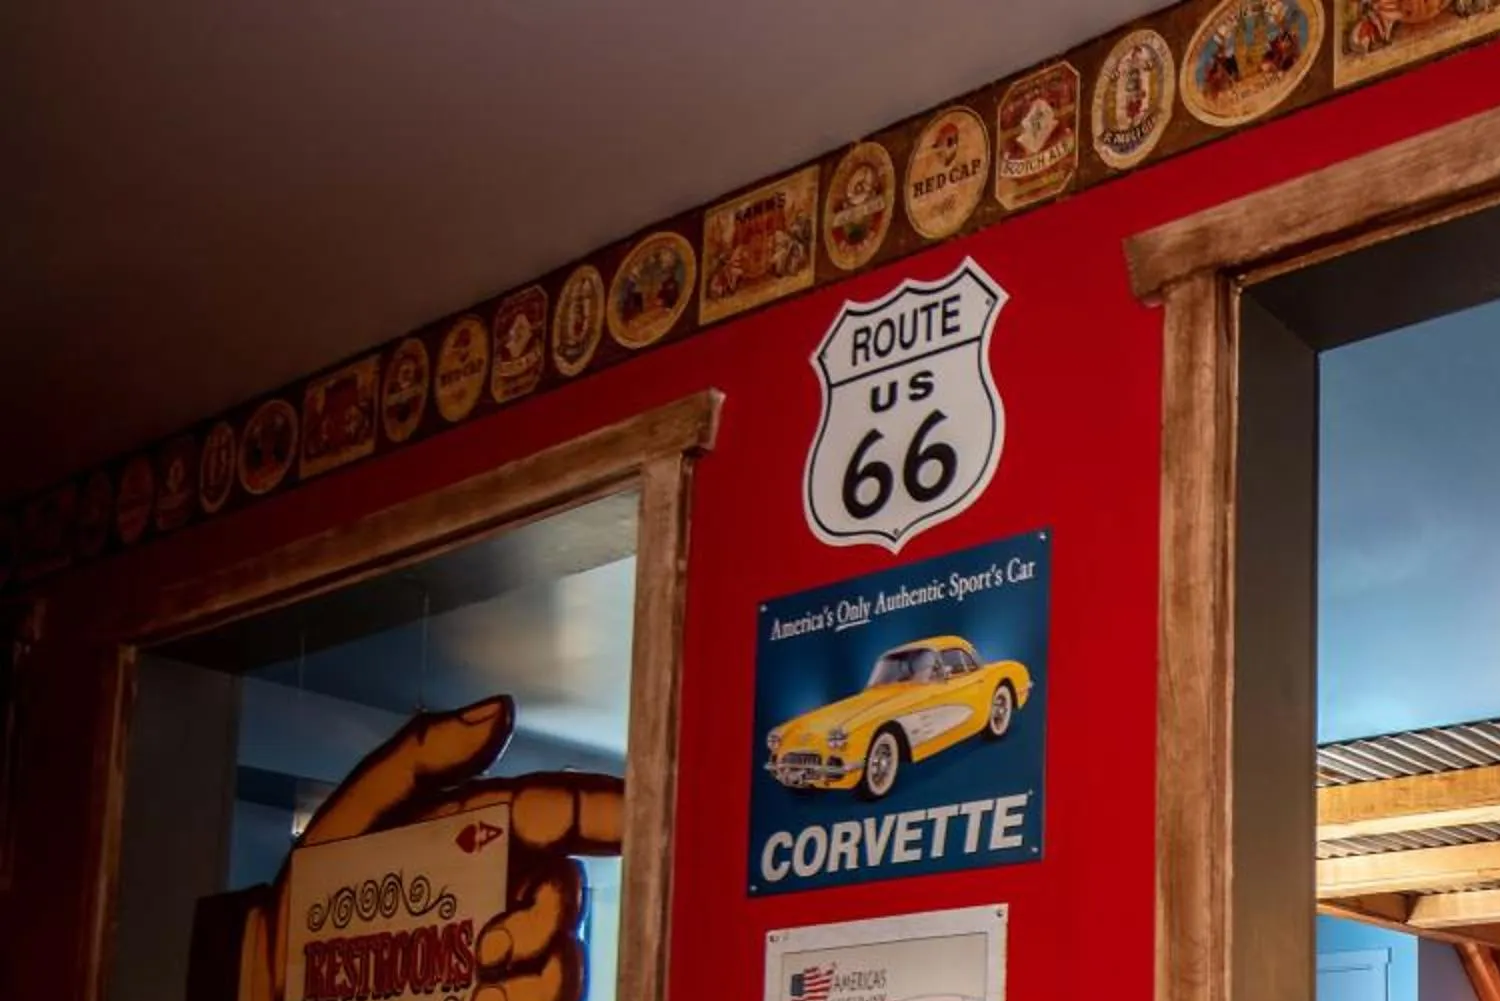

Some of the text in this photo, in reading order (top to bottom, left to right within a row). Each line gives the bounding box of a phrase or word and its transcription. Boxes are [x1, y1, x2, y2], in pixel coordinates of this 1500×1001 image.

[912, 159, 981, 198] RED CAP
[851, 294, 961, 367] ROUTE
[870, 370, 934, 413] US
[841, 409, 958, 520] 66
[770, 557, 1036, 641] America's Only Authentic Sport's Car
[760, 793, 1029, 883] CORVETTE
